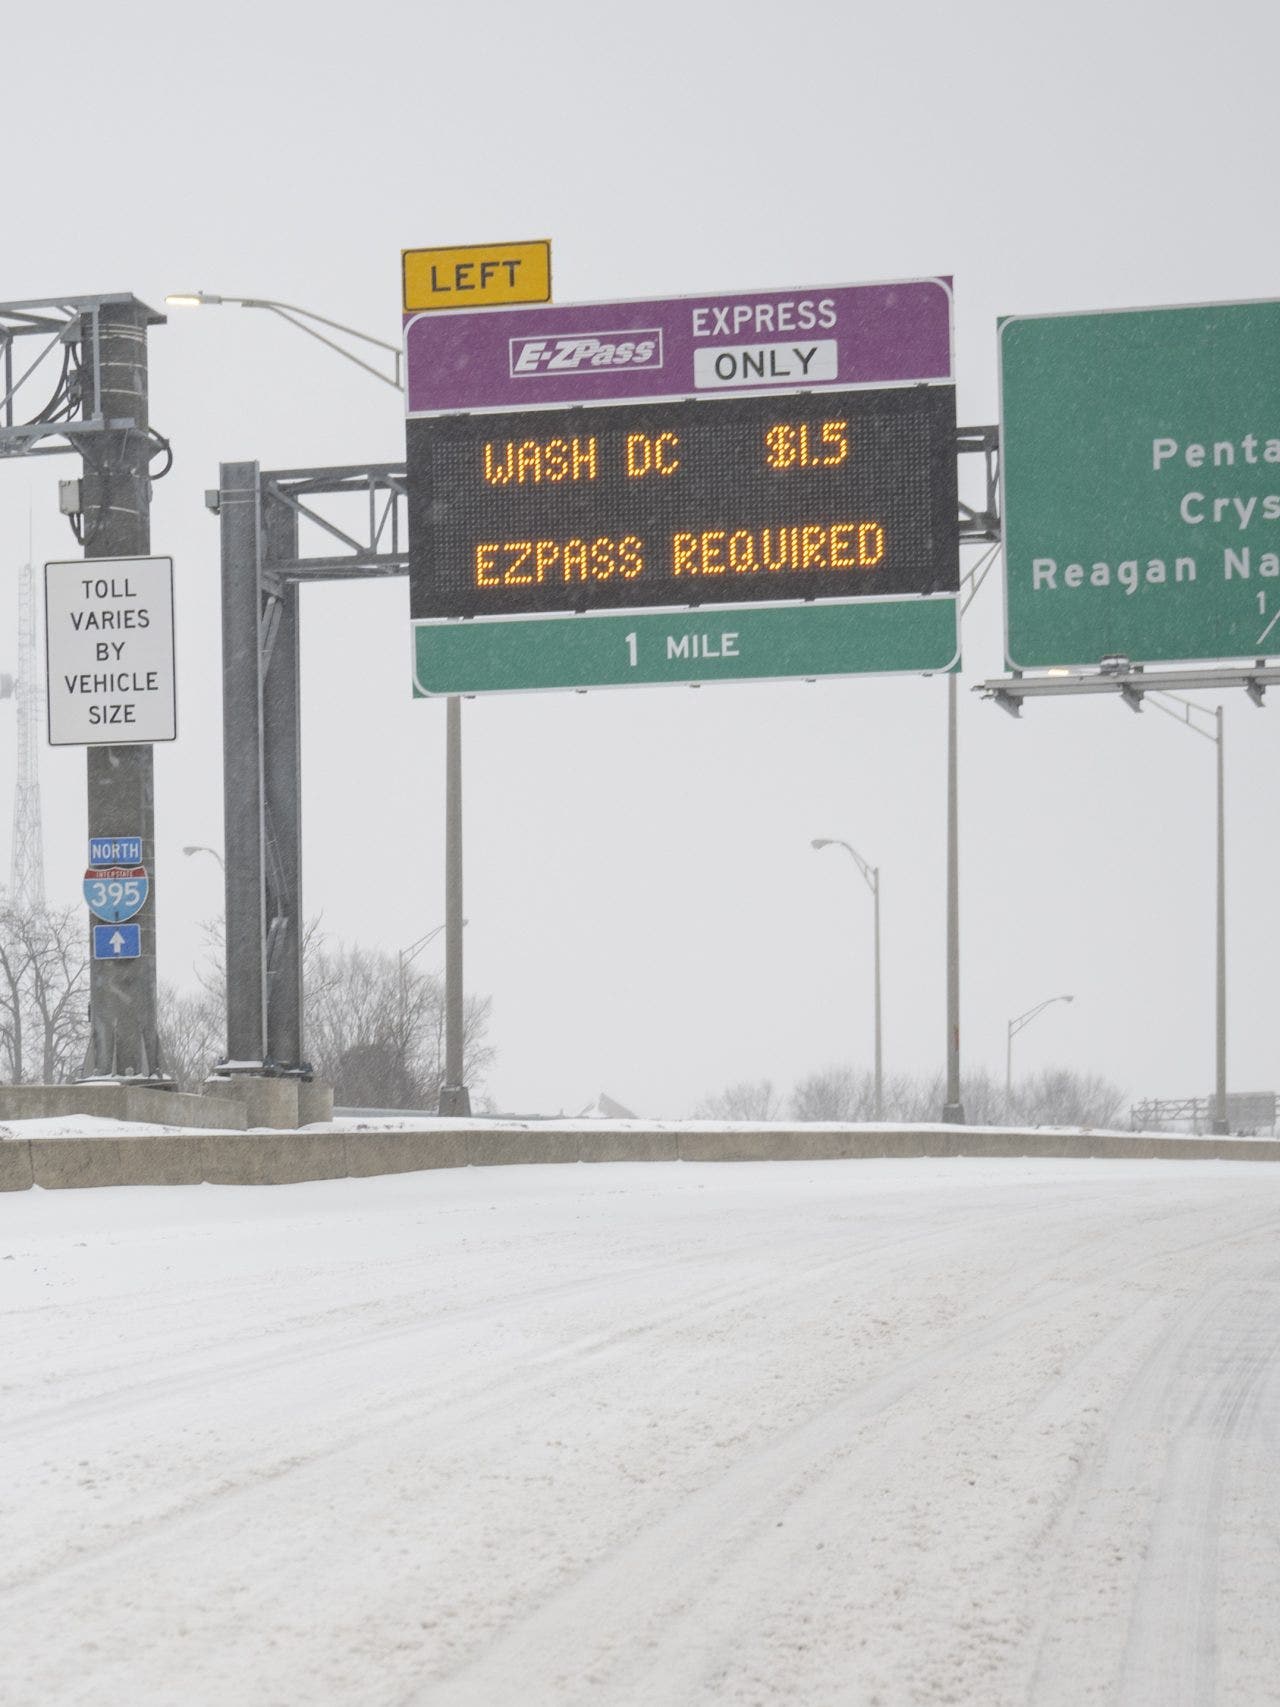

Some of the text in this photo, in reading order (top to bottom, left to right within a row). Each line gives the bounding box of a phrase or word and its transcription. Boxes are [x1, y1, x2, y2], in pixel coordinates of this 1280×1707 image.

[431, 260, 522, 292] LEFT
[693, 300, 837, 336] EXPRESS
[515, 339, 657, 371] E-ZPass
[715, 348, 818, 380] ONLY
[482, 438, 598, 485] WASH
[626, 432, 680, 477] DC
[476, 521, 885, 588] EZPASS REQUIRED
[82, 579, 137, 599] TOLL
[1032, 556, 1195, 595] Reagan
[70, 609, 150, 631] VARIES
[96, 642, 125, 661] BY
[625, 633, 740, 666] 1 MILE
[64, 671, 159, 694] VEHICLE
[88, 704, 136, 724] SIZE
[92, 843, 139, 859] NORTH
[91, 881, 140, 908] 395
